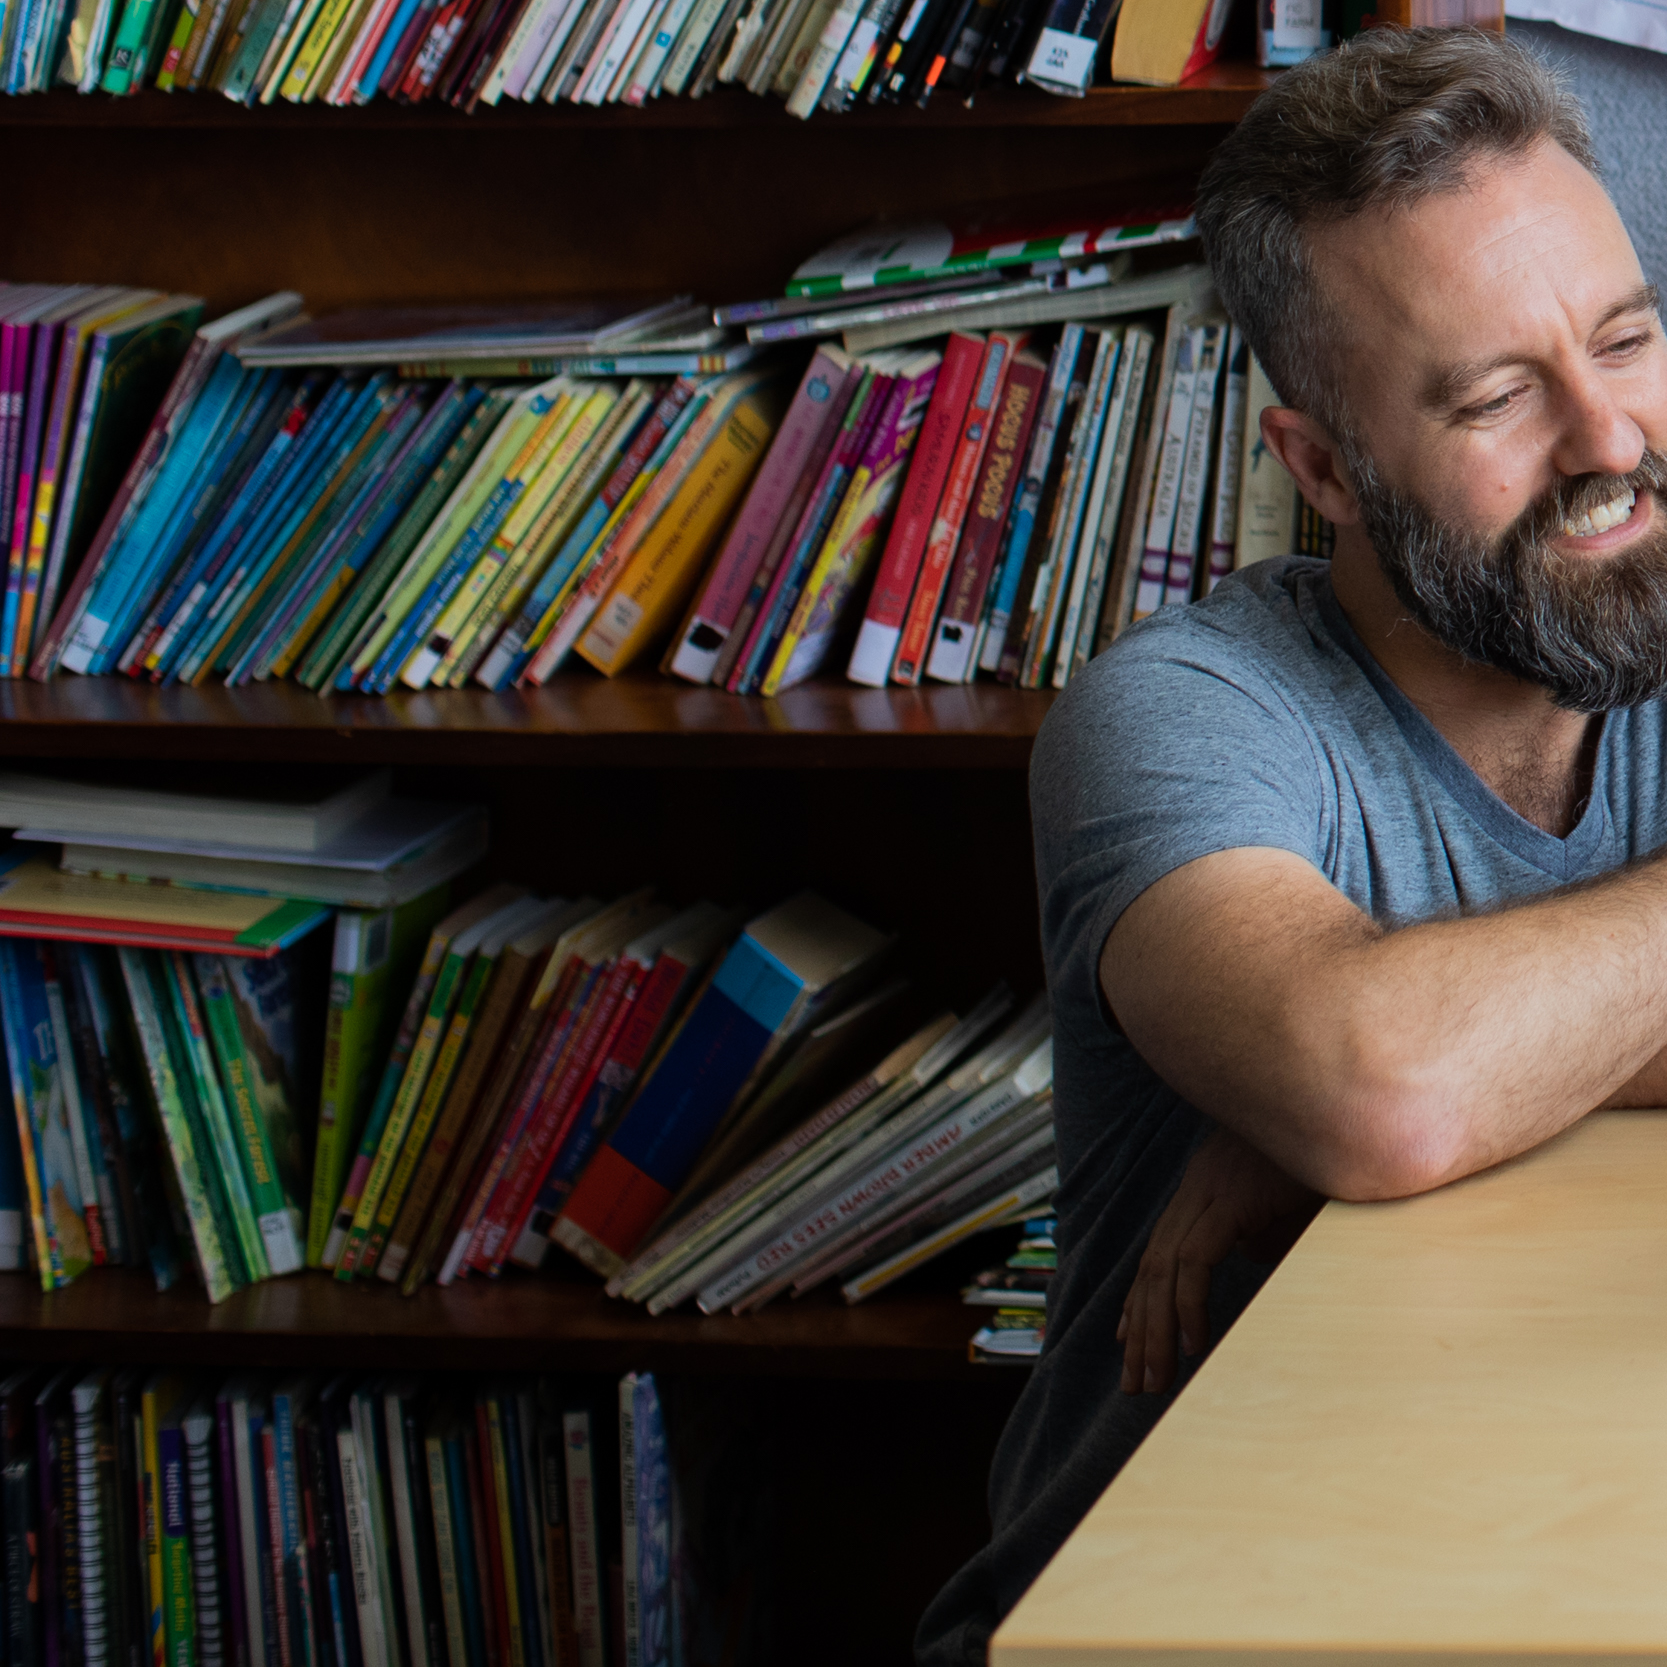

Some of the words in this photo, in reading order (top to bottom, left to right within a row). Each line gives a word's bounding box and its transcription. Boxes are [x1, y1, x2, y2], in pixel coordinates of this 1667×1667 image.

[998, 383, 1032, 450] HOCUS
[977, 450, 1018, 521] POCUS
[898, 1121, 966, 1176] AMBER
[833, 1163, 903, 1217] BROWN
[750, 1232, 793, 1272] RED
[787, 1204, 839, 1247] SEES
[165, 1458, 184, 1528] National
